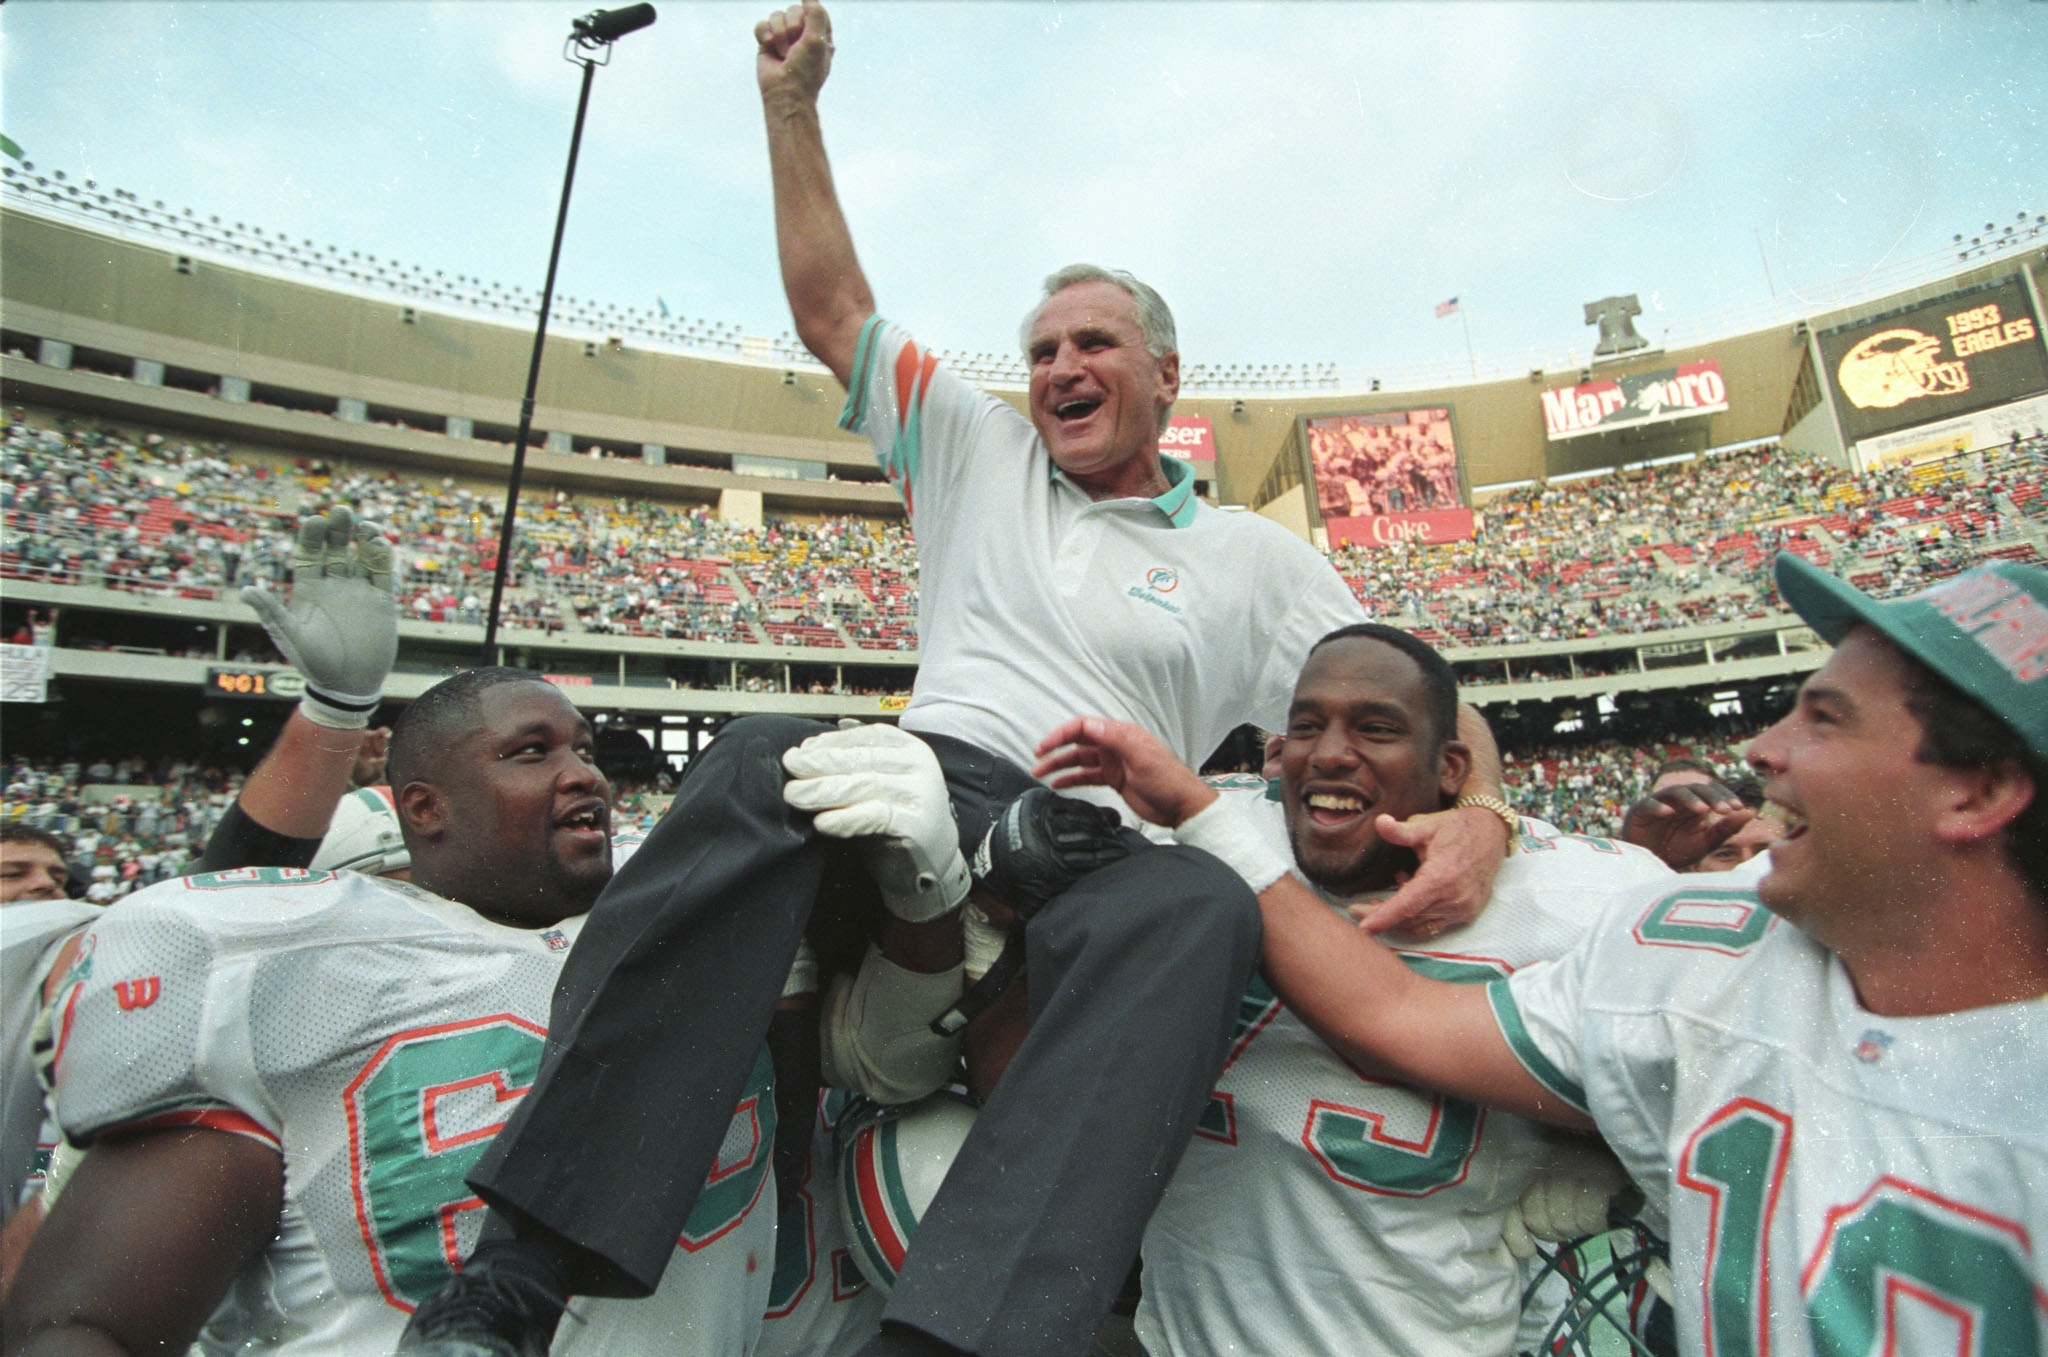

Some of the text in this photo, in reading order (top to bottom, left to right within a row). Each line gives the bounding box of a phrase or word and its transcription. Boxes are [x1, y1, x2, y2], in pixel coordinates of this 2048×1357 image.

[1945, 303, 2002, 336] 1993
[1951, 317, 2036, 357] EAGLES
[1158, 426, 1208, 445] ser
[1372, 516, 1432, 545] Coke
